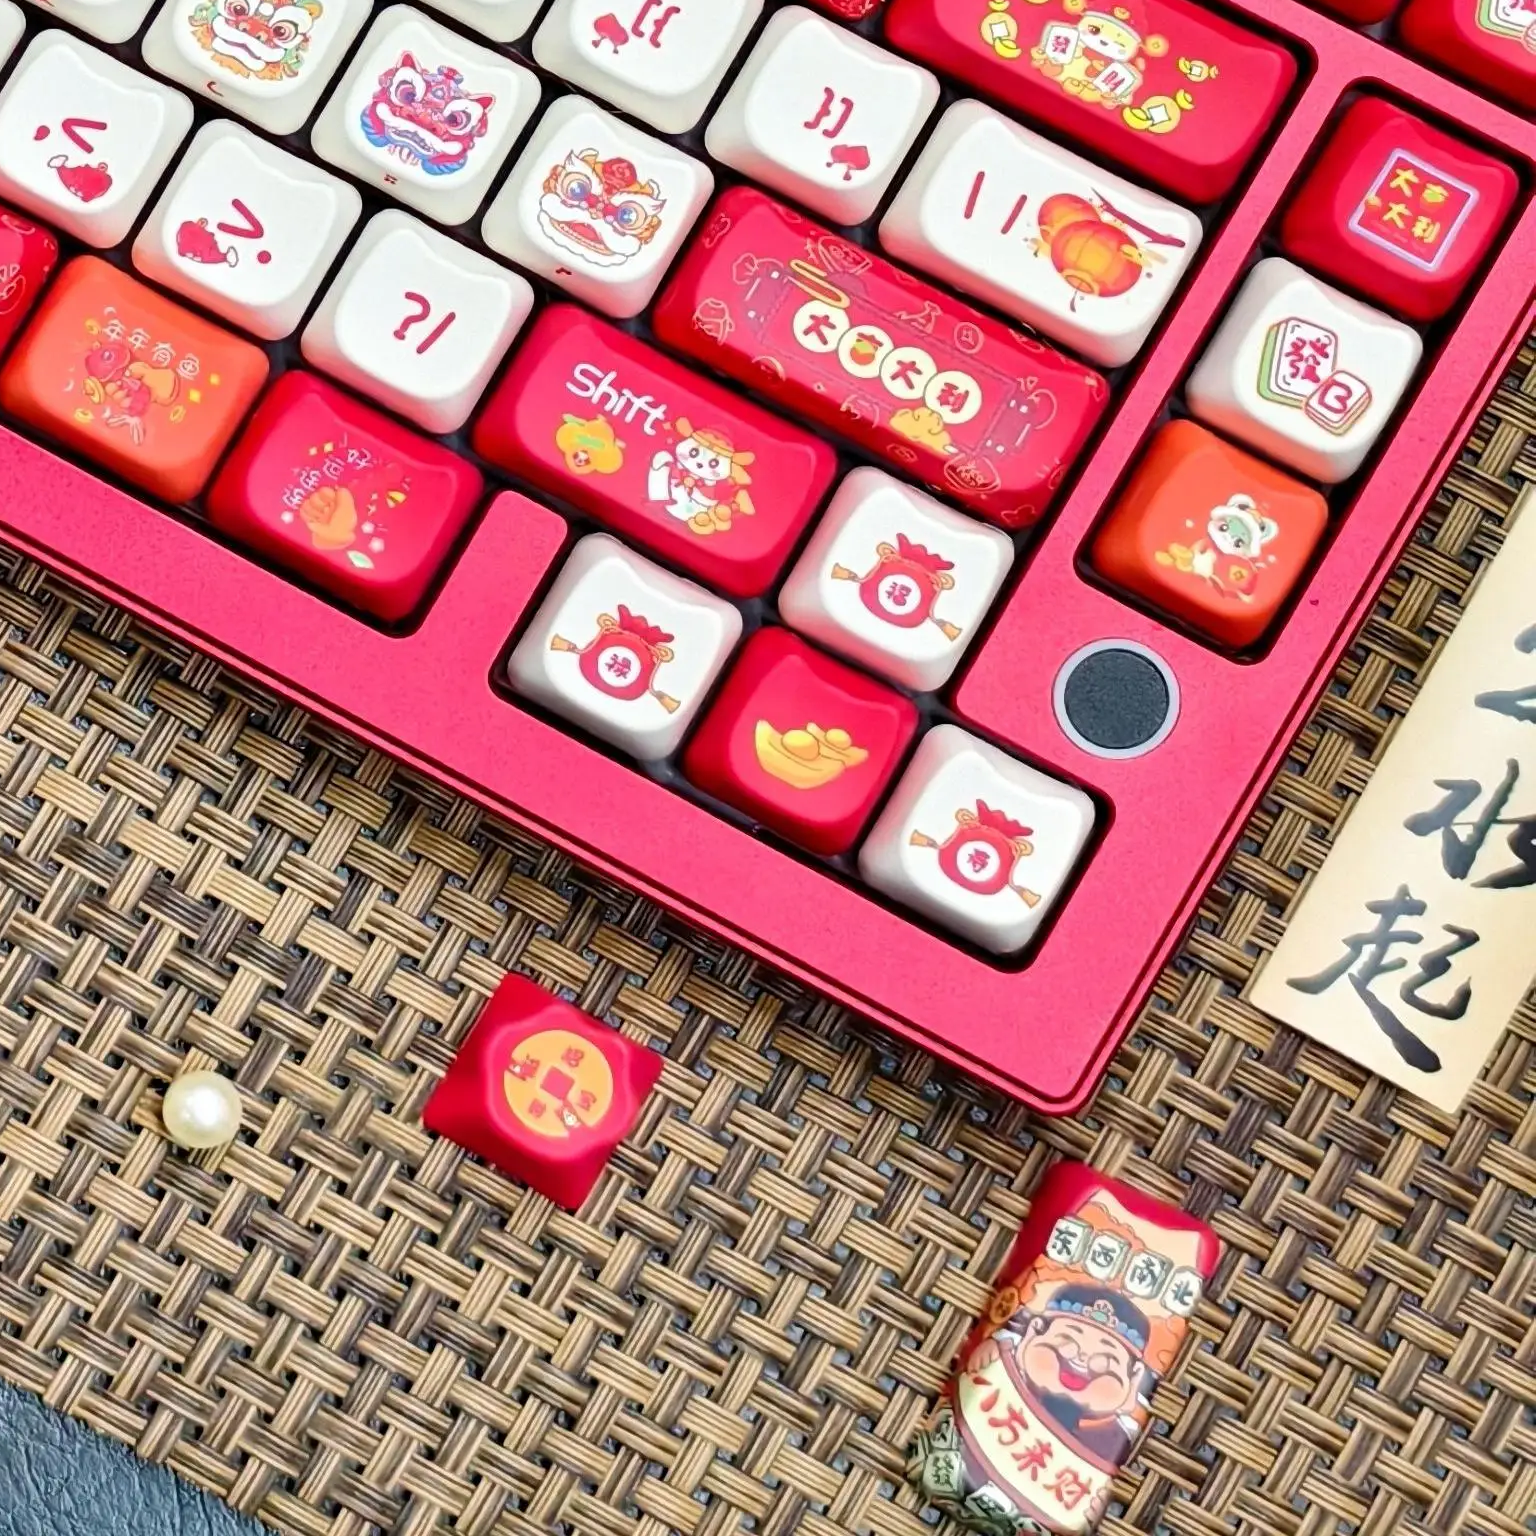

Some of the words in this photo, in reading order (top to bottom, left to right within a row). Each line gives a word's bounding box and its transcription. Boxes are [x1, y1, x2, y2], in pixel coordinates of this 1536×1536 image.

[565, 363, 666, 436] Shift
[1318, 380, 1353, 414] B
[1052, 1226, 1195, 1305] 东西南北
[973, 1375, 1093, 1510] 八方来财
